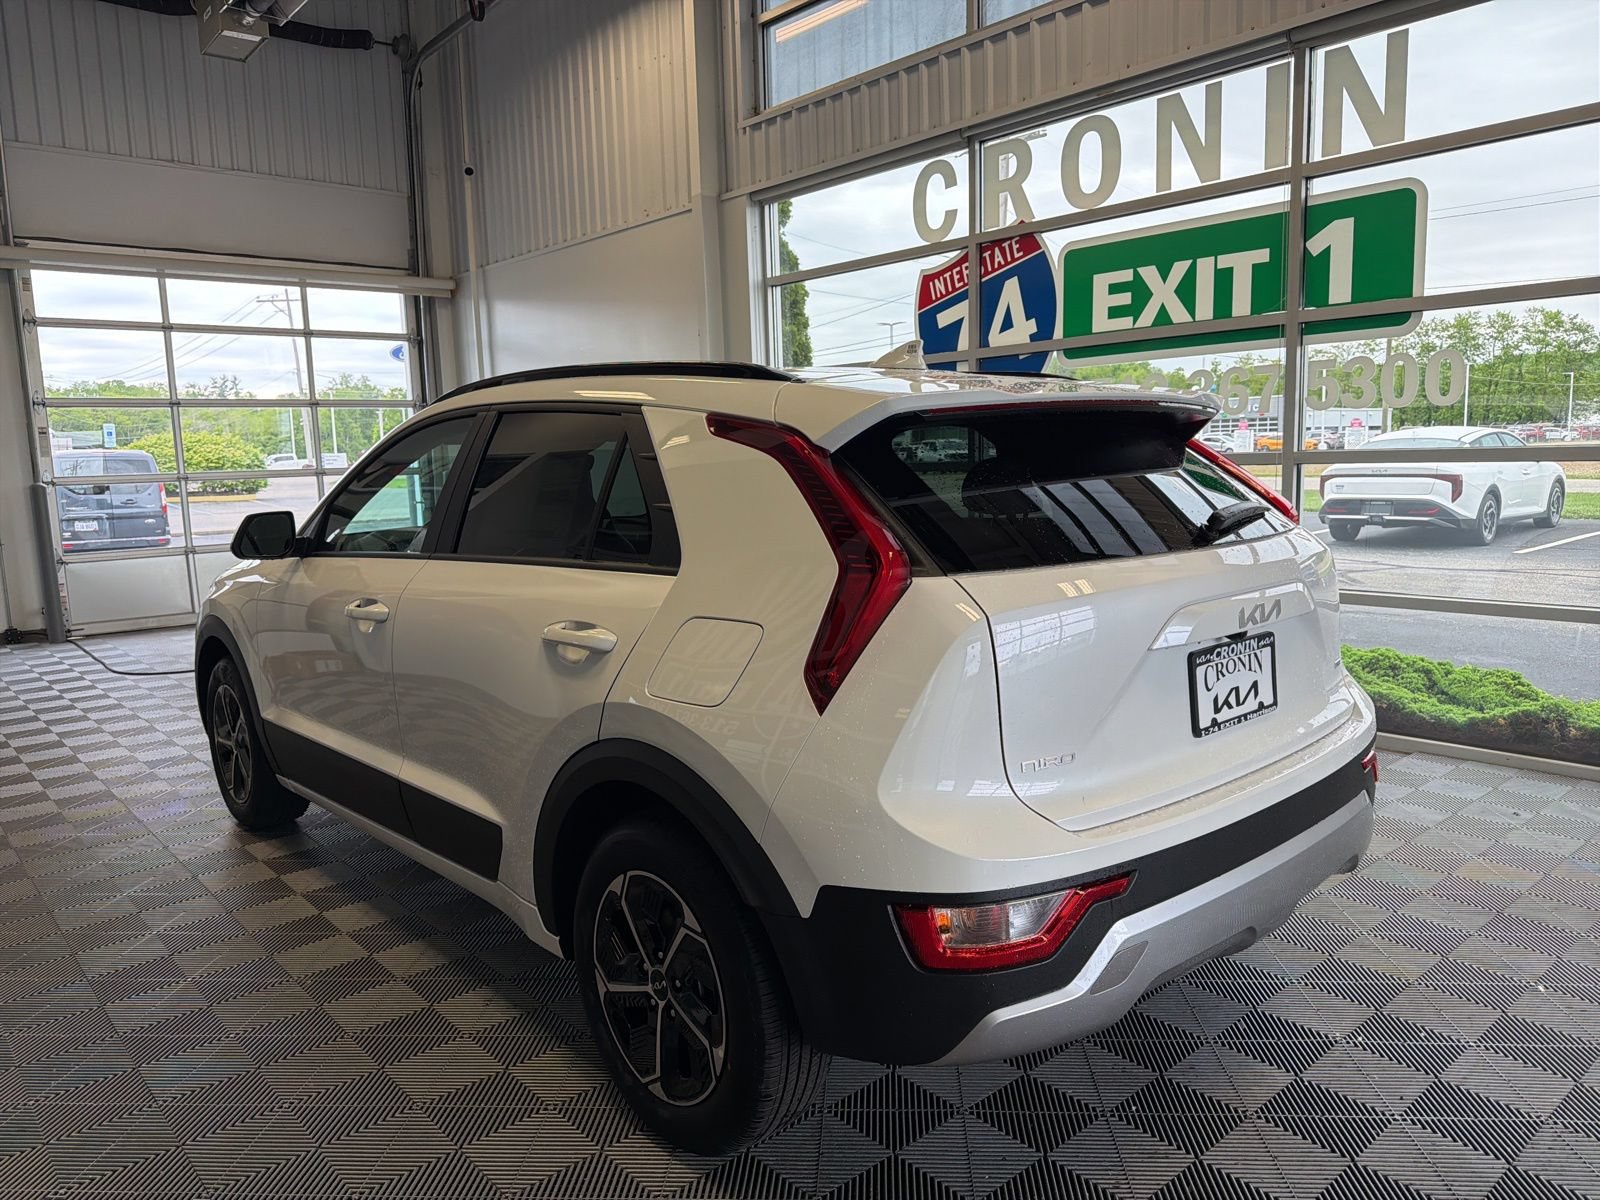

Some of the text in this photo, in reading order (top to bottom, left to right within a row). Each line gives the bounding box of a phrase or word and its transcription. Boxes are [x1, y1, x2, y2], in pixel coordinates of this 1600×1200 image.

[913, 28, 1410, 243] CRONIN
[929, 237, 1024, 301] INTERTATE
[1092, 217, 1354, 333] EXIT 1
[1305, 350, 1466, 411] 5300
[1238, 599, 1282, 629] KIA
[1213, 638, 1258, 661] CRONIN
[1204, 650, 1263, 692] CRONIN
[1213, 680, 1259, 715] KIA
[1220, 718, 1239, 730] EXIT
[1247, 706, 1277, 720] Harrison
[1020, 752, 1076, 773] NIRO
